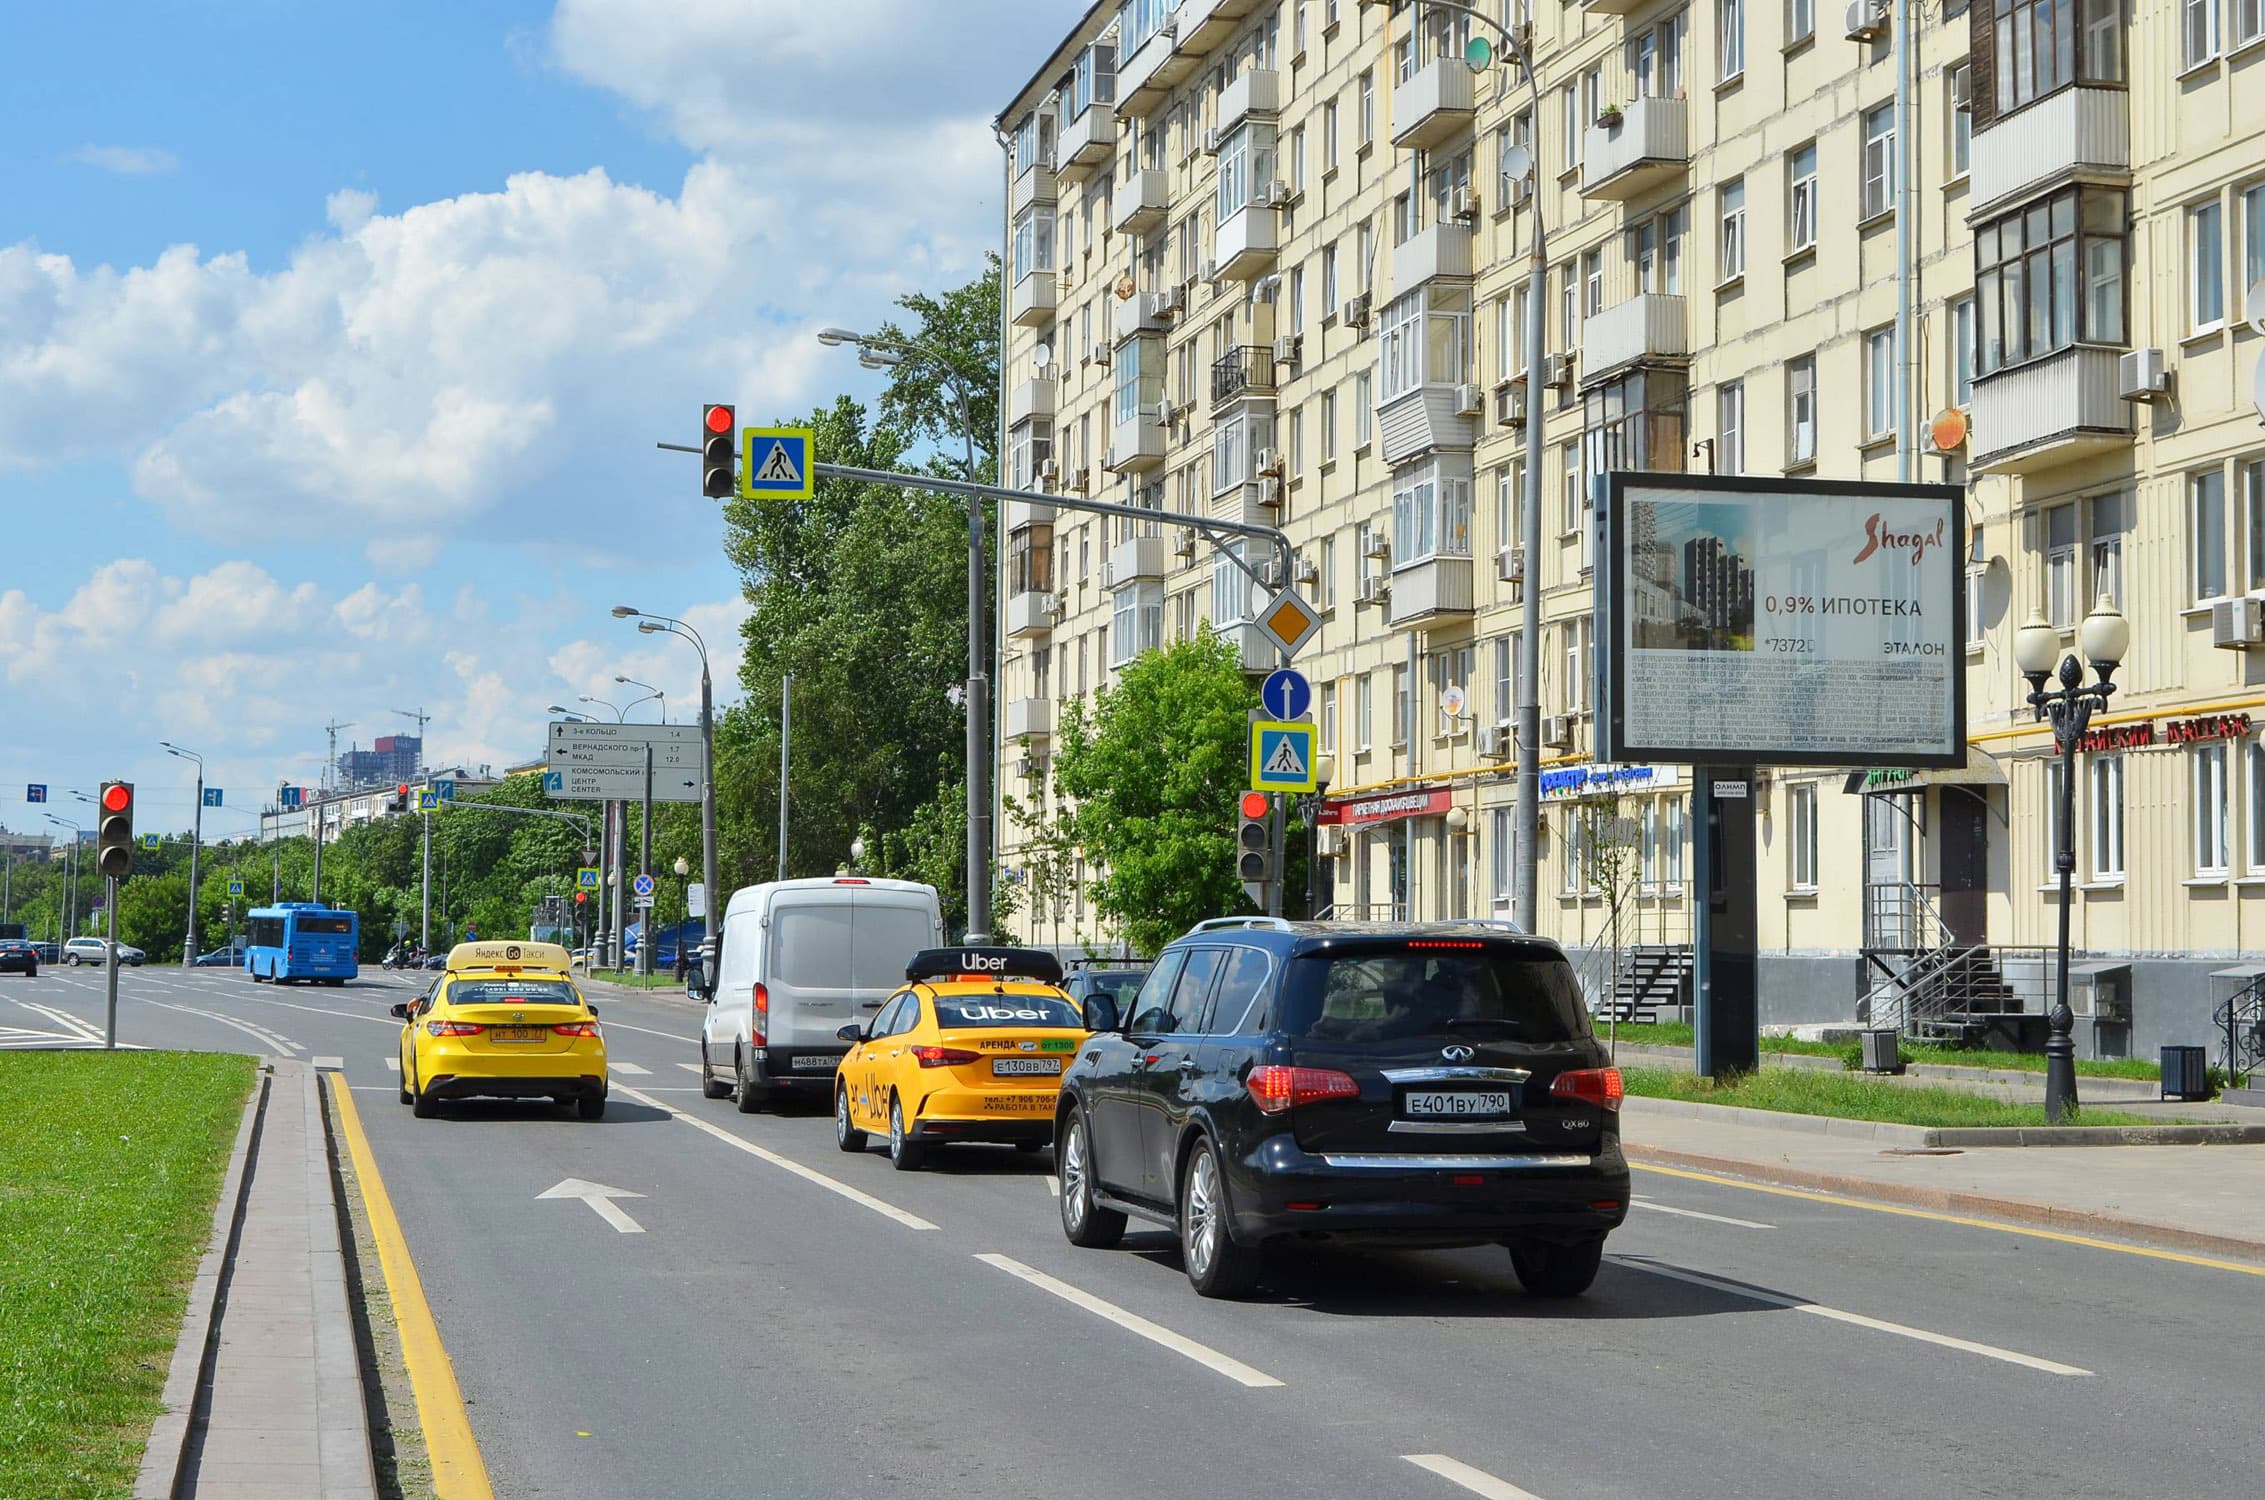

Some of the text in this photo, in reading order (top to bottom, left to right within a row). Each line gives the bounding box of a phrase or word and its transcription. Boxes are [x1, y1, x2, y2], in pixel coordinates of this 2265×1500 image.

[1853, 513, 1944, 566] Shagal
[1765, 596, 1922, 616] 0,9% ИПОТЕКА
[1883, 642, 1945, 656] ЭТАЛОН
[2166, 713, 2250, 745] МАССАЖ
[572, 768, 640, 776] КОМСОМОЛЬСКИЙ
[572, 778, 596, 786] ЦЕНТР
[475, 948, 504, 958] Яндекс
[508, 949, 520, 958] Go
[524, 949, 544, 958] Такси
[962, 953, 1008, 970] Uber
[960, 1007, 1050, 1020] Uber
[512, 1030, 528, 1038] 100
[980, 1041, 1016, 1050] АРЕНДА
[1562, 1120, 1590, 1129] QX80
